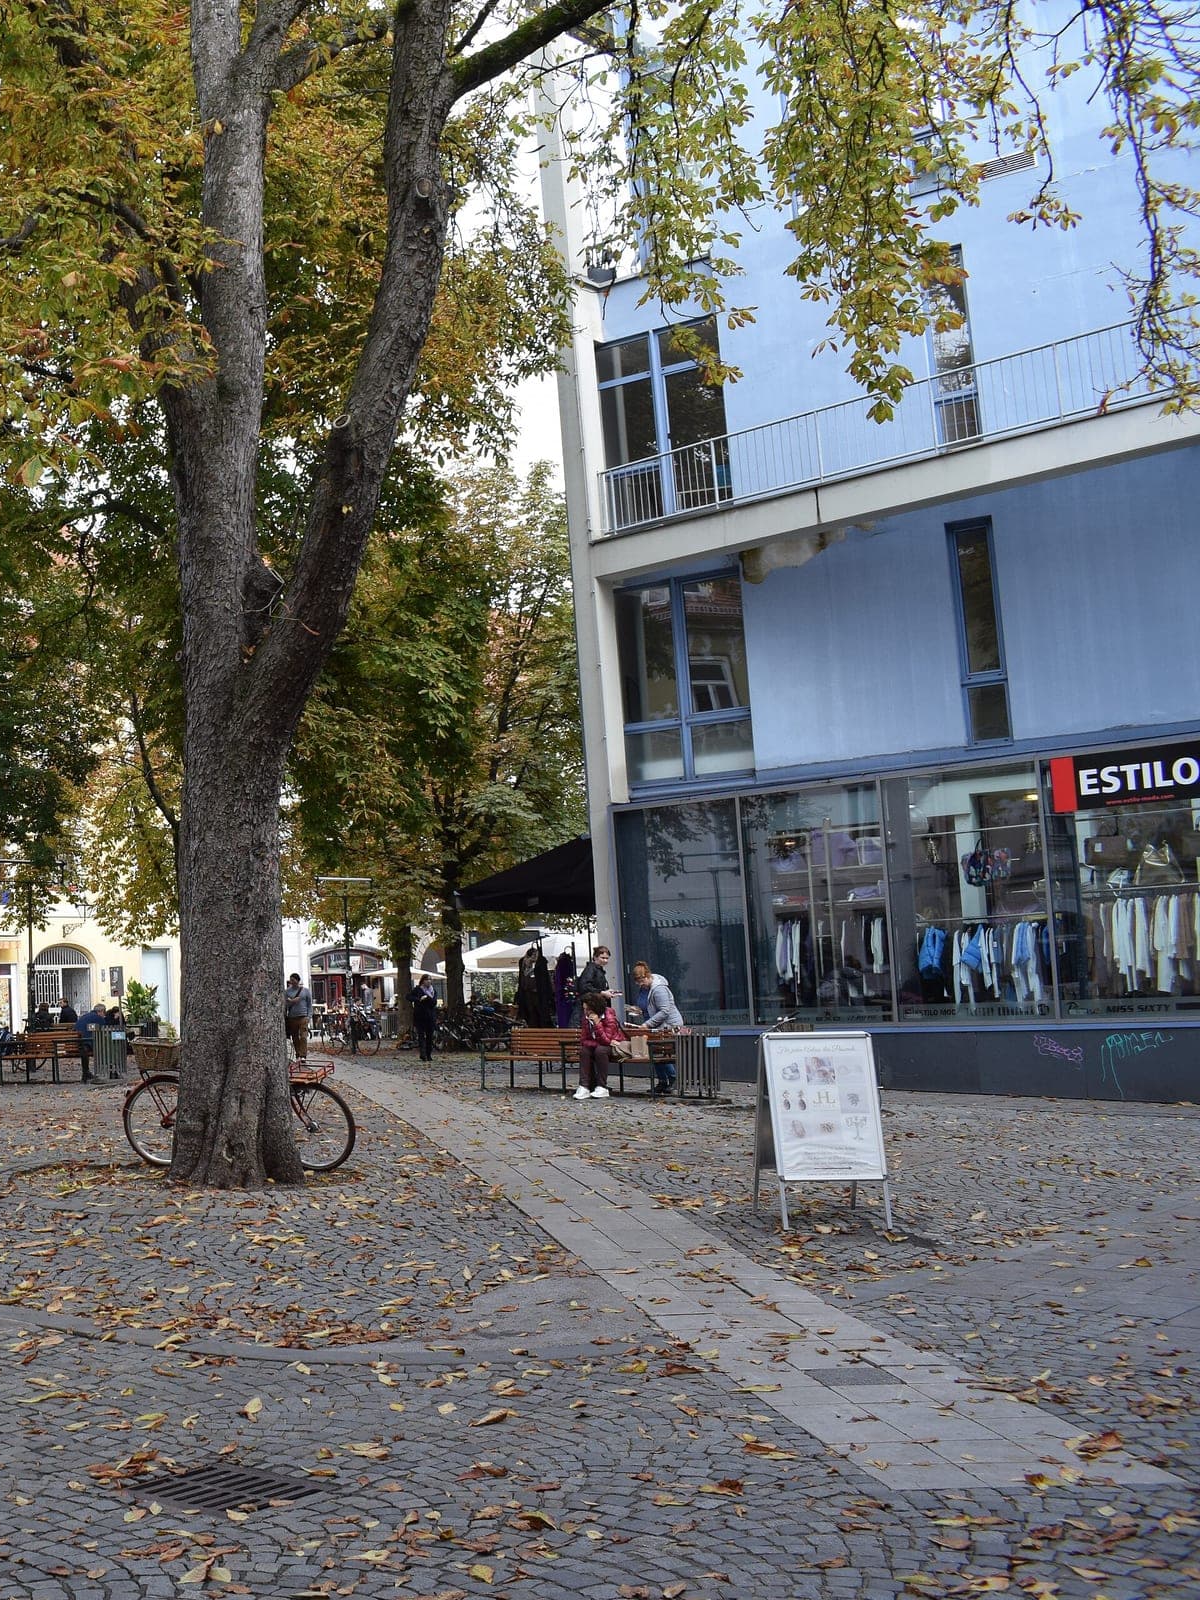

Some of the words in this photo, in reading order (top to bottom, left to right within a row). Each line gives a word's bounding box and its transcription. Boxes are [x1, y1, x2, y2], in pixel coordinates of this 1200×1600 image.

[1078, 757, 1200, 795] ESTILO
[1106, 1005, 1135, 1014] MISS
[1136, 1004, 1170, 1013] SIXTY
